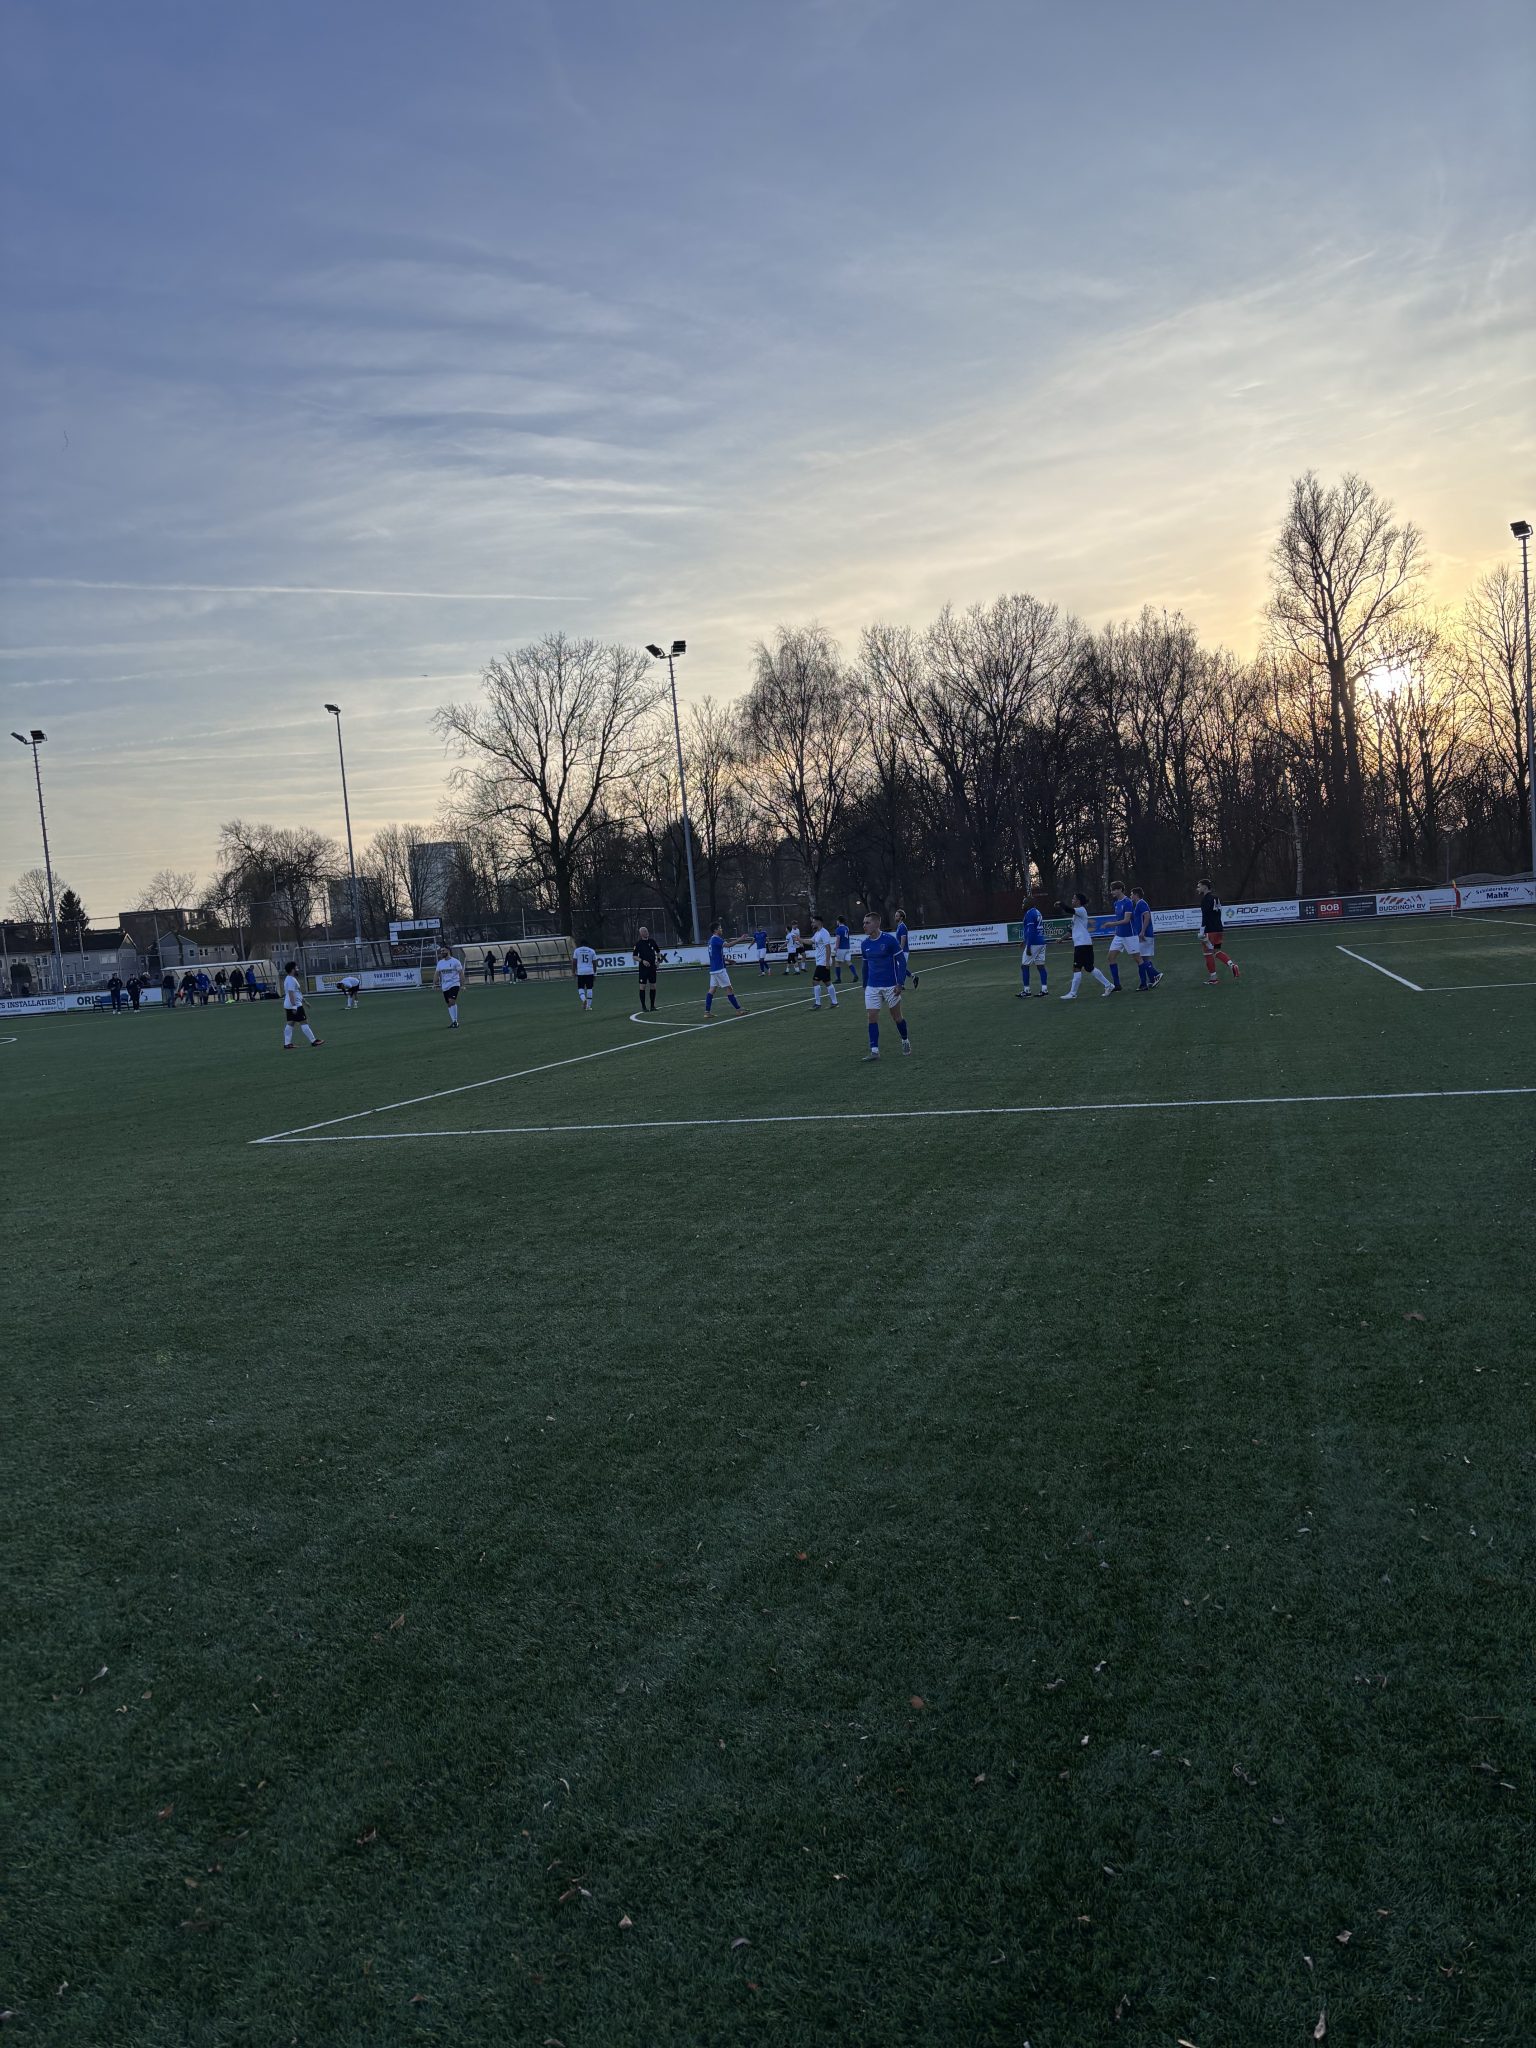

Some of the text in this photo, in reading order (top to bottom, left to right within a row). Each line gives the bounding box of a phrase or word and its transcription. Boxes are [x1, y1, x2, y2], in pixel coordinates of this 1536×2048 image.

[1486, 891, 1509, 899] MahR
[1259, 905, 1297, 913] RECLAME
[1320, 904, 1340, 912] BOB
[582, 954, 589, 964] 15
[596, 956, 626, 968] ORIS
[7, 998, 57, 1009] INSTALLATIES
